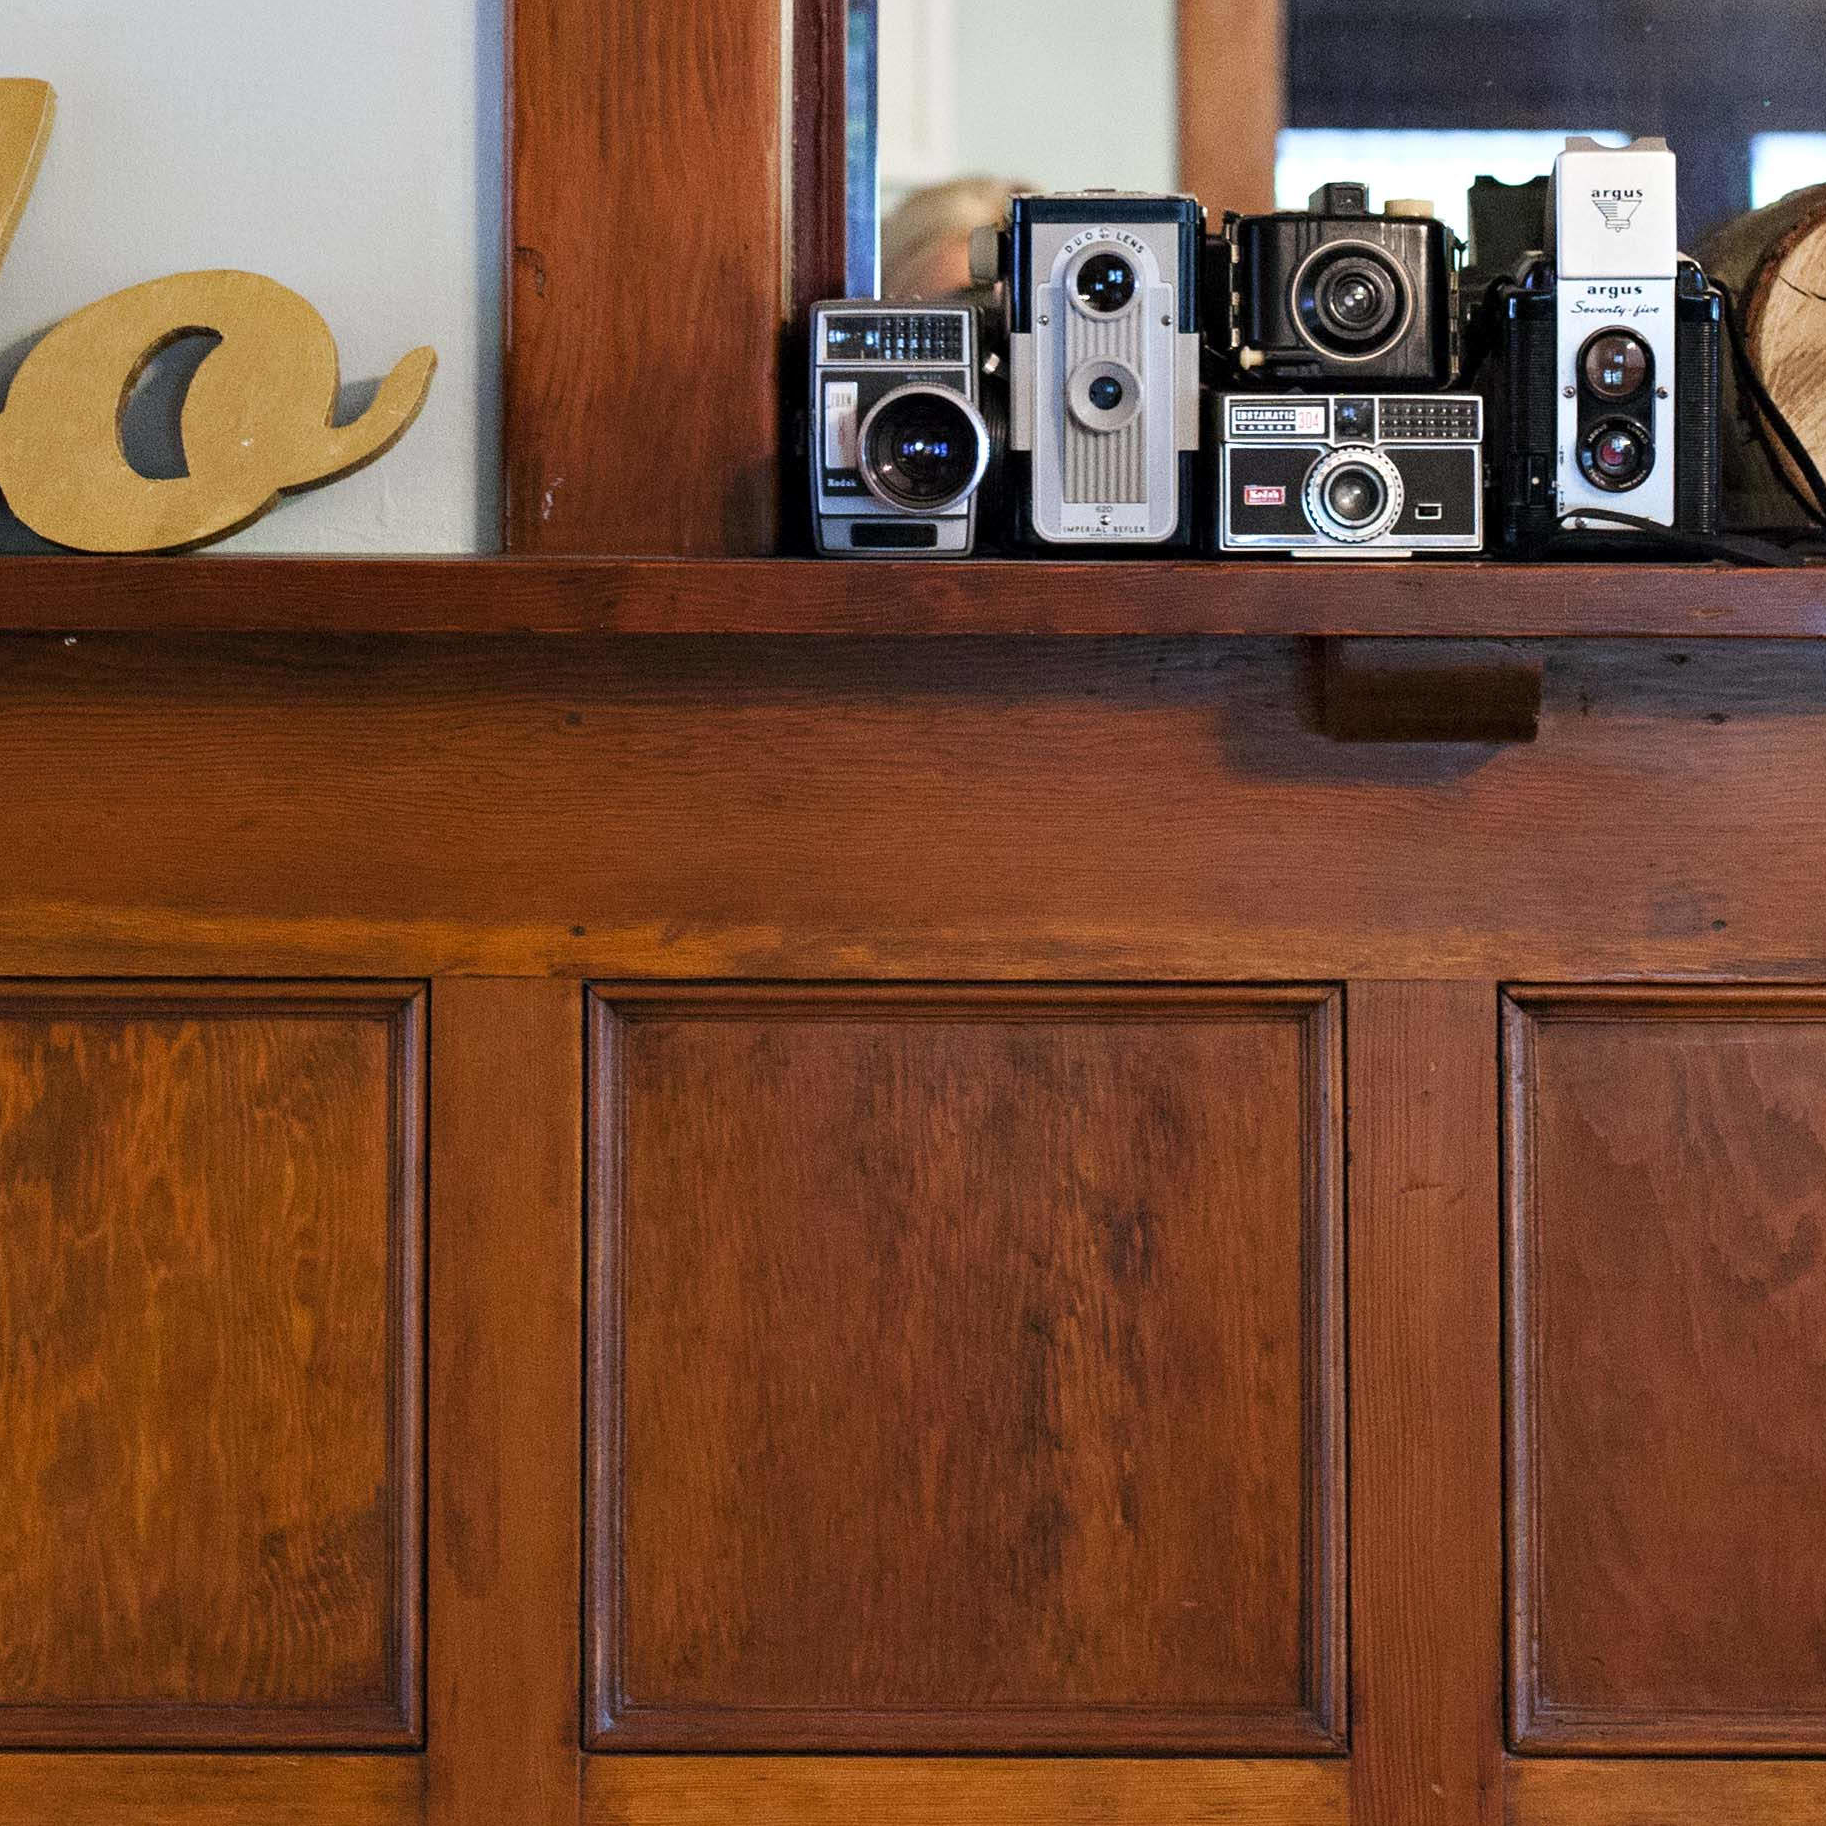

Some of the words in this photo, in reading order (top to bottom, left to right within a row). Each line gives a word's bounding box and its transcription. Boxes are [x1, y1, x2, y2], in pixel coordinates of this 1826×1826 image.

[1591, 189, 1643, 201] argus
[1065, 232, 1094, 254] DUO
[1116, 231, 1145, 254] LENS
[1587, 285, 1642, 299] argus
[1571, 300, 1659, 317] Seventy-five
[1236, 410, 1295, 421] INSTAMATIC
[1298, 411, 1320, 429] 304
[827, 478, 857, 487] Kodak
[1249, 489, 1279, 498] Kodak
